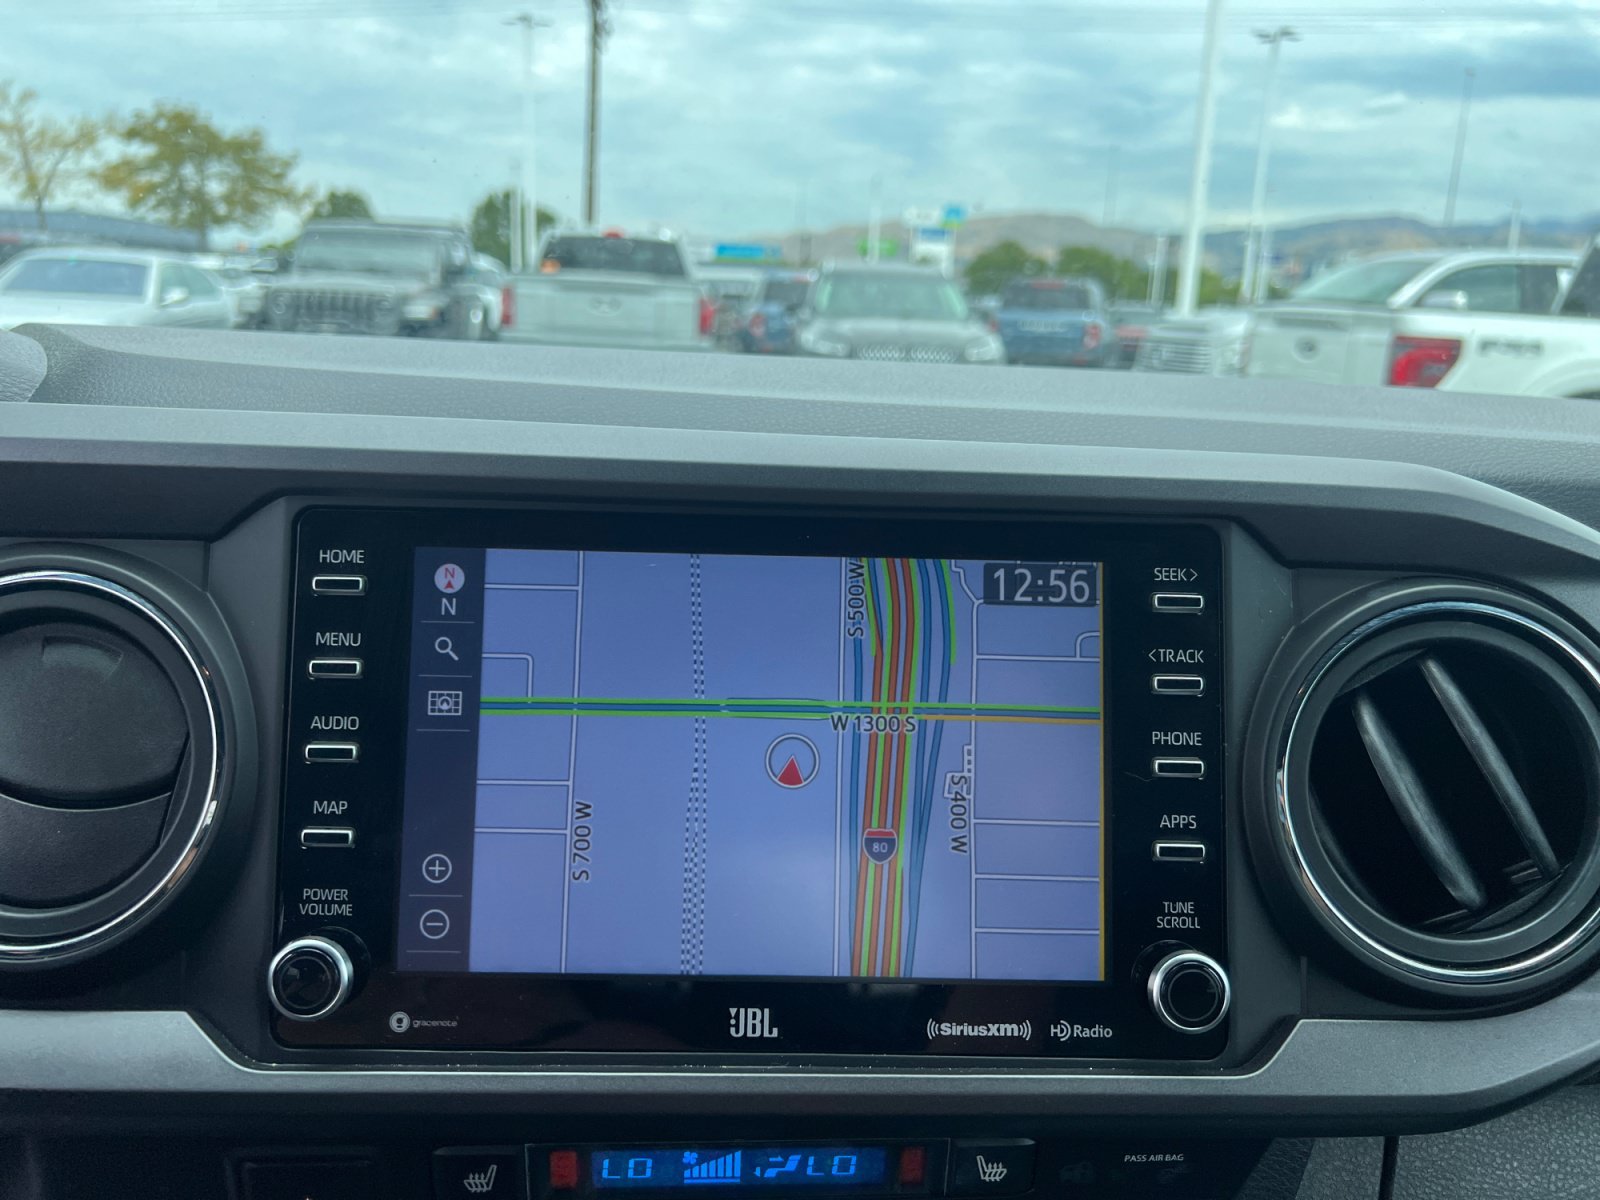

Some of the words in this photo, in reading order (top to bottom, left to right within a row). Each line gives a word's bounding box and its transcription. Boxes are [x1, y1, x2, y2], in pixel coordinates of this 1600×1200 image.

[319, 549, 365, 564] HOME
[444, 567, 456, 579] N
[993, 568, 1090, 603] 12:56
[441, 598, 457, 616] N
[847, 584, 865, 620] 500
[315, 632, 362, 647] MENU
[310, 716, 360, 731] AUDIO
[831, 714, 849, 732] W
[854, 715, 900, 733] 1300
[905, 715, 916, 733] S
[1151, 731, 1202, 746] PHONE
[950, 774, 968, 786] S
[313, 800, 348, 815] MAP
[574, 801, 593, 820] W
[950, 790, 968, 830] 400
[1159, 814, 1197, 829] APPS
[572, 825, 592, 864] 700
[872, 842, 888, 853] 80
[950, 834, 968, 854] W
[572, 869, 590, 881] S
[303, 888, 349, 901] POWER
[299, 903, 353, 917] VOLUME
[1163, 901, 1195, 914] TUNE
[1156, 916, 1201, 929] SCROLL
[729, 1007, 778, 1037] JBL
[1050, 1020, 1072, 1041] HD
[1073, 1023, 1113, 1038] Radio
[1124, 1154, 1147, 1162] PASS
[1148, 1154, 1164, 1162] AIR
[1165, 1153, 1184, 1162] BAG
